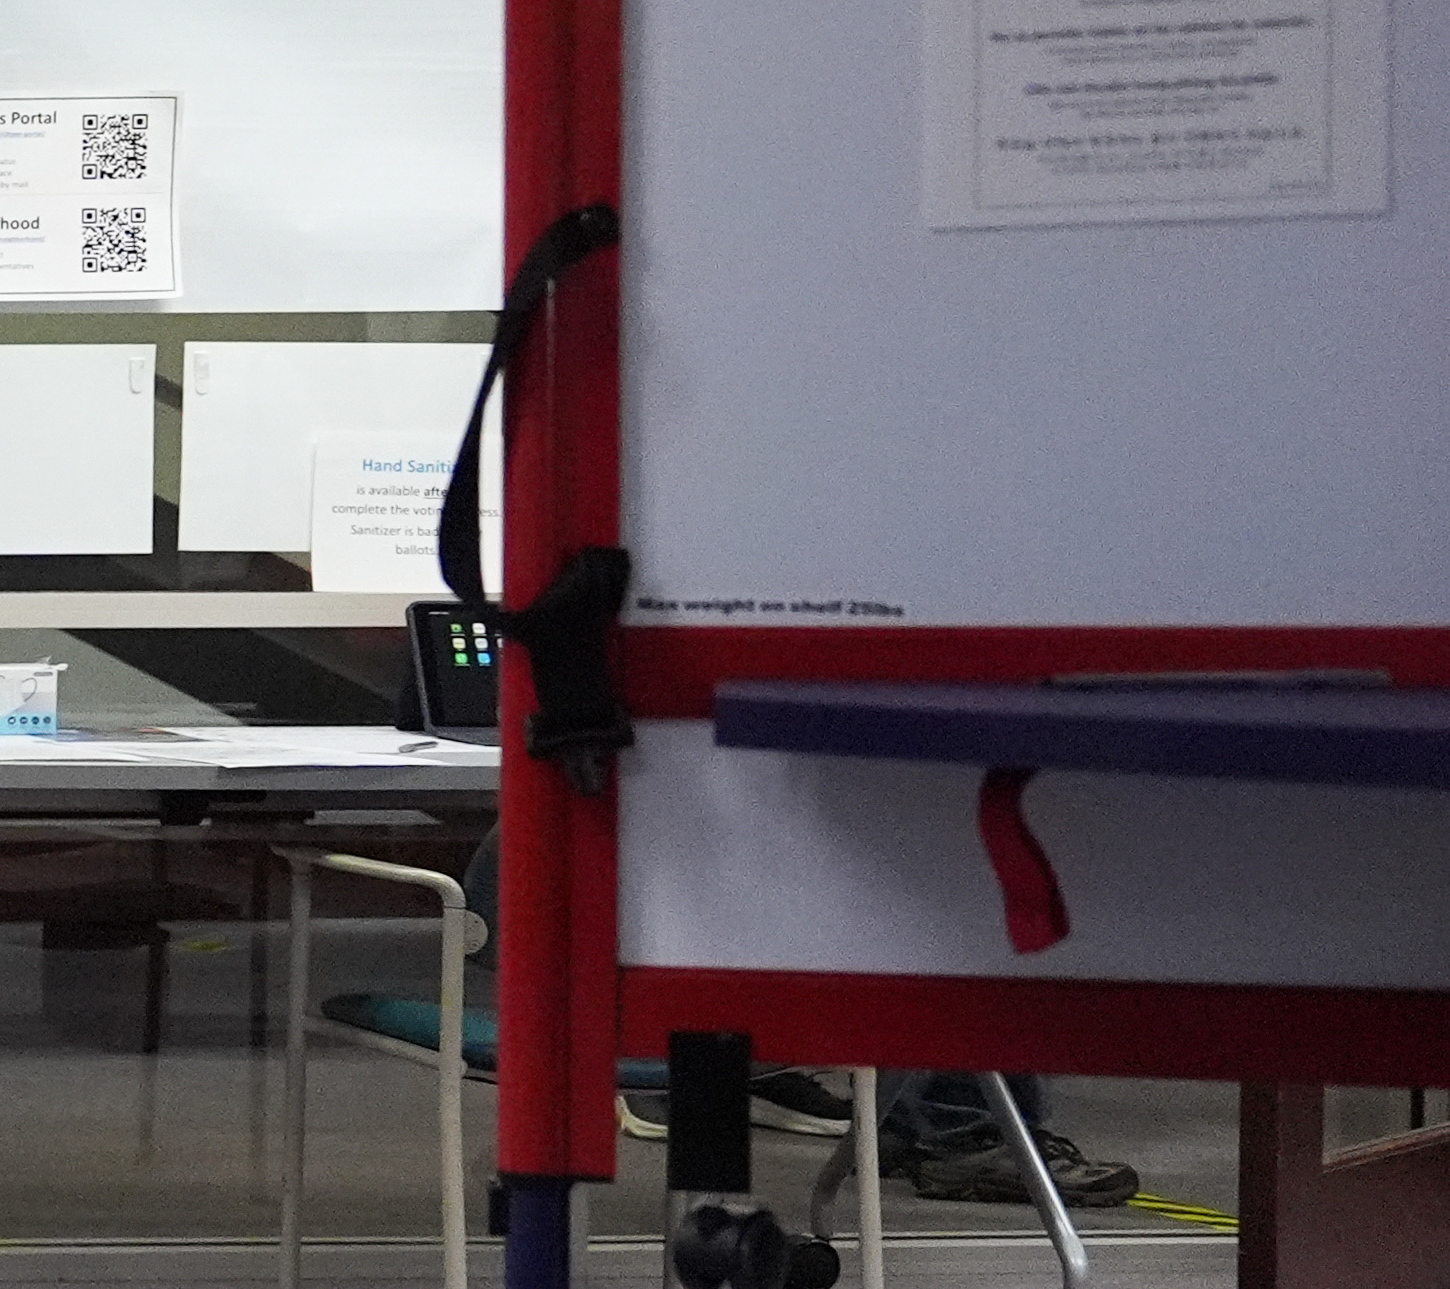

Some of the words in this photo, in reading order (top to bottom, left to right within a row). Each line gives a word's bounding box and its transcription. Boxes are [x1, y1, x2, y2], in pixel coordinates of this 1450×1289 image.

[11, 110, 57, 125] Portal
[362, 459, 403, 473] Hand
[407, 459, 454, 473] Saniti
[356, 485, 365, 494] is
[368, 485, 421, 496] available
[423, 486, 448, 497] afte
[332, 503, 388, 515] complete
[390, 505, 410, 515] the
[351, 524, 402, 536] Sanitizer
[404, 526, 415, 536] is
